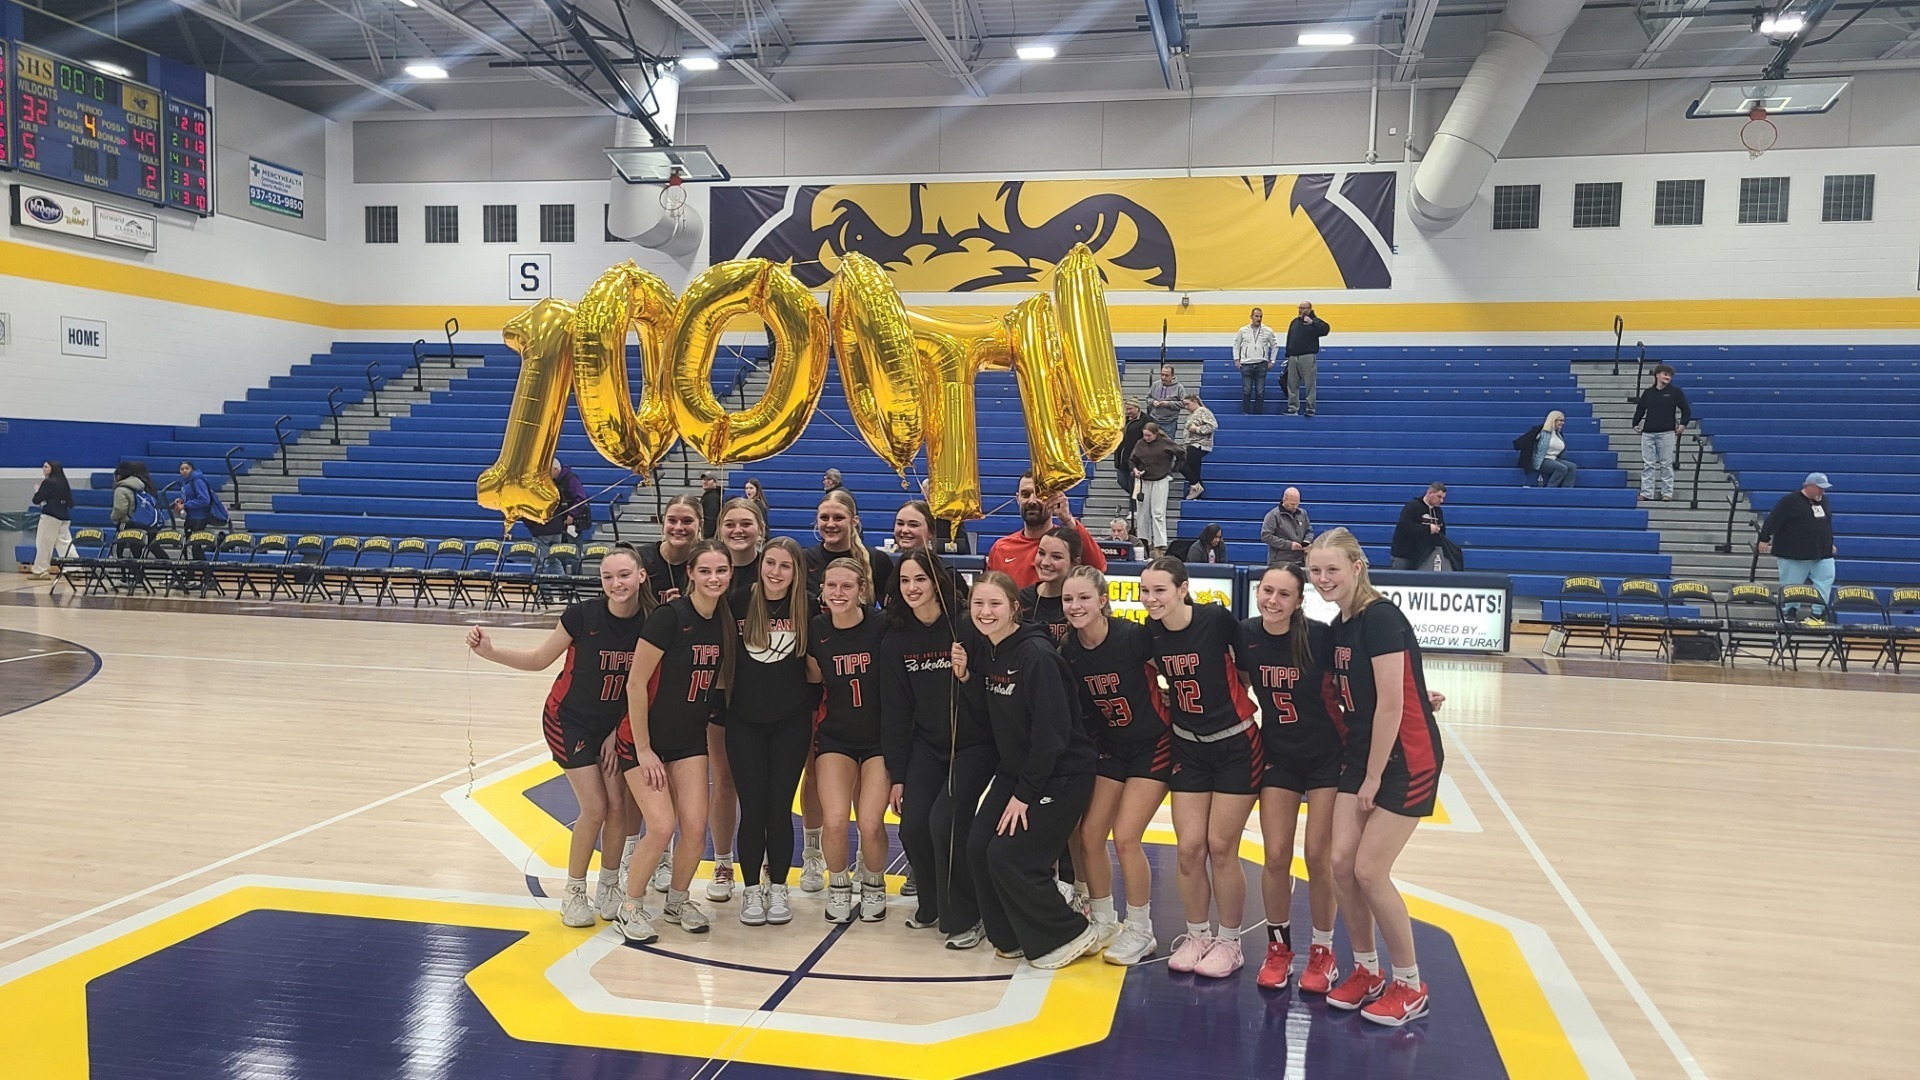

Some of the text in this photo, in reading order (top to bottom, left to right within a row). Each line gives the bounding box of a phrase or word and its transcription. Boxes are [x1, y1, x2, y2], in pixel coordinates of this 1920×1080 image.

[18, 56, 52, 80] SHS
[18, 79, 58, 100] WILDCATS
[23, 94, 48, 125] 32
[57, 106, 78, 120] POSS
[77, 102, 103, 117] PERIOD
[57, 119, 84, 134] BONUS
[84, 114, 96, 137] 4
[102, 120, 120, 133] POSS
[126, 112, 158, 131] GUEST
[22, 132, 35, 159] 5
[72, 135, 121, 156] PLAYER FOUL
[97, 130, 121, 145] BONUS
[133, 128, 156, 154] 49
[19, 158, 41, 171] CORE
[138, 153, 159, 166] FOULS
[84, 174, 108, 187] MATCH
[146, 165, 156, 190] 2
[137, 187, 160, 199] SCORE
[30, 198, 60, 219] Kroger
[99, 213, 125, 223] forward
[521, 263, 539, 291] S
[68, 328, 99, 347] HOME
[1565, 577, 1600, 589] SPRINGFIELD
[1622, 580, 1657, 592] SPRINGFIELD
[1672, 581, 1708, 594] SPRINGFIELD
[1732, 585, 1770, 597] SPRINGFIELD
[1783, 586, 1818, 598] SPRINGFIELD
[1408, 591, 1502, 614] WILDCATS!
[1837, 588, 1874, 600] SPRINGFIELD
[1412, 623, 1459, 634] NSORED
[1449, 637, 1460, 646] W.
[1463, 638, 1501, 648] FURAY
[692, 645, 719, 665] TIPP
[833, 652, 871, 676] TIPP
[1162, 653, 1199, 676] TIPP
[1334, 646, 1351, 670] TIPP
[600, 674, 625, 701] 11
[687, 670, 714, 702] 14
[1084, 672, 1120, 695] TIPP
[1260, 665, 1300, 689] TIPP
[850, 678, 862, 707] 1
[1174, 679, 1203, 713] 12
[1094, 696, 1132, 727] 23
[1272, 691, 1298, 723] 5
